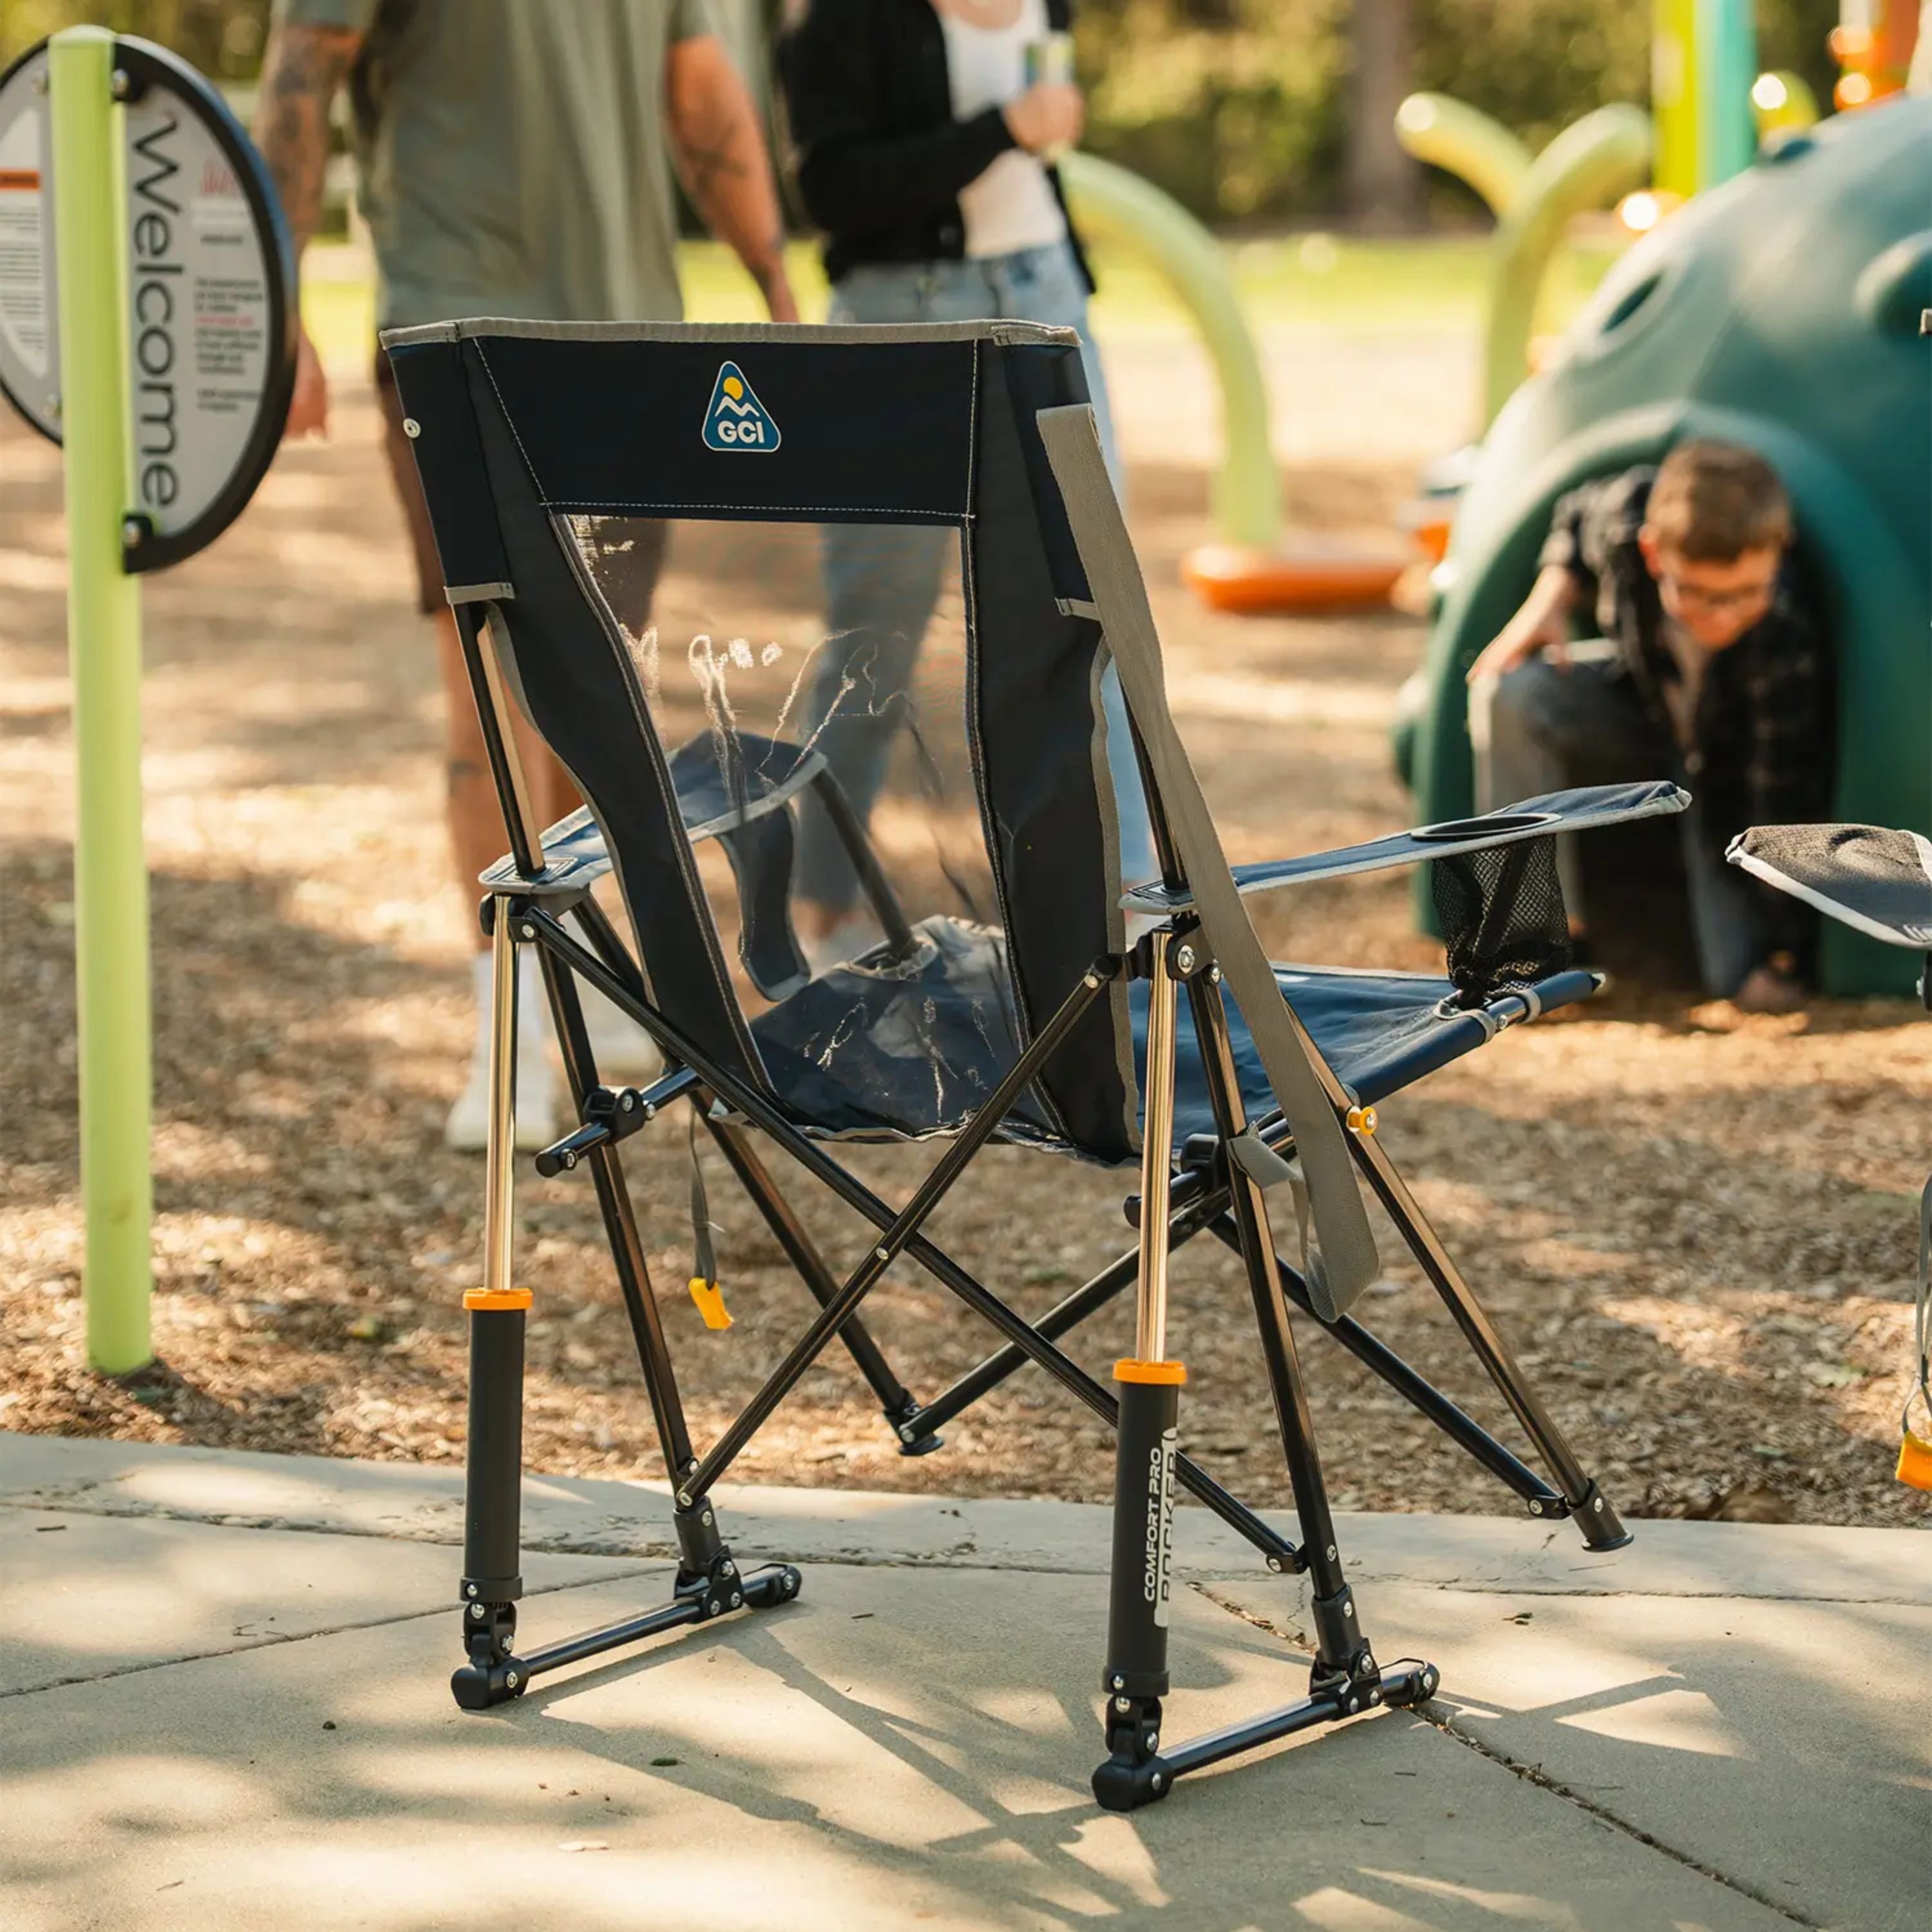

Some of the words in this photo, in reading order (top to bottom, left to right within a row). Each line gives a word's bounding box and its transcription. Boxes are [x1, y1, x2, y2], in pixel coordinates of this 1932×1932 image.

[133, 116, 184, 507] Welcome
[717, 420, 765, 444] GCI
[1148, 1447, 1162, 1495] PRO
[1144, 1497, 1159, 1602] COMFORT
